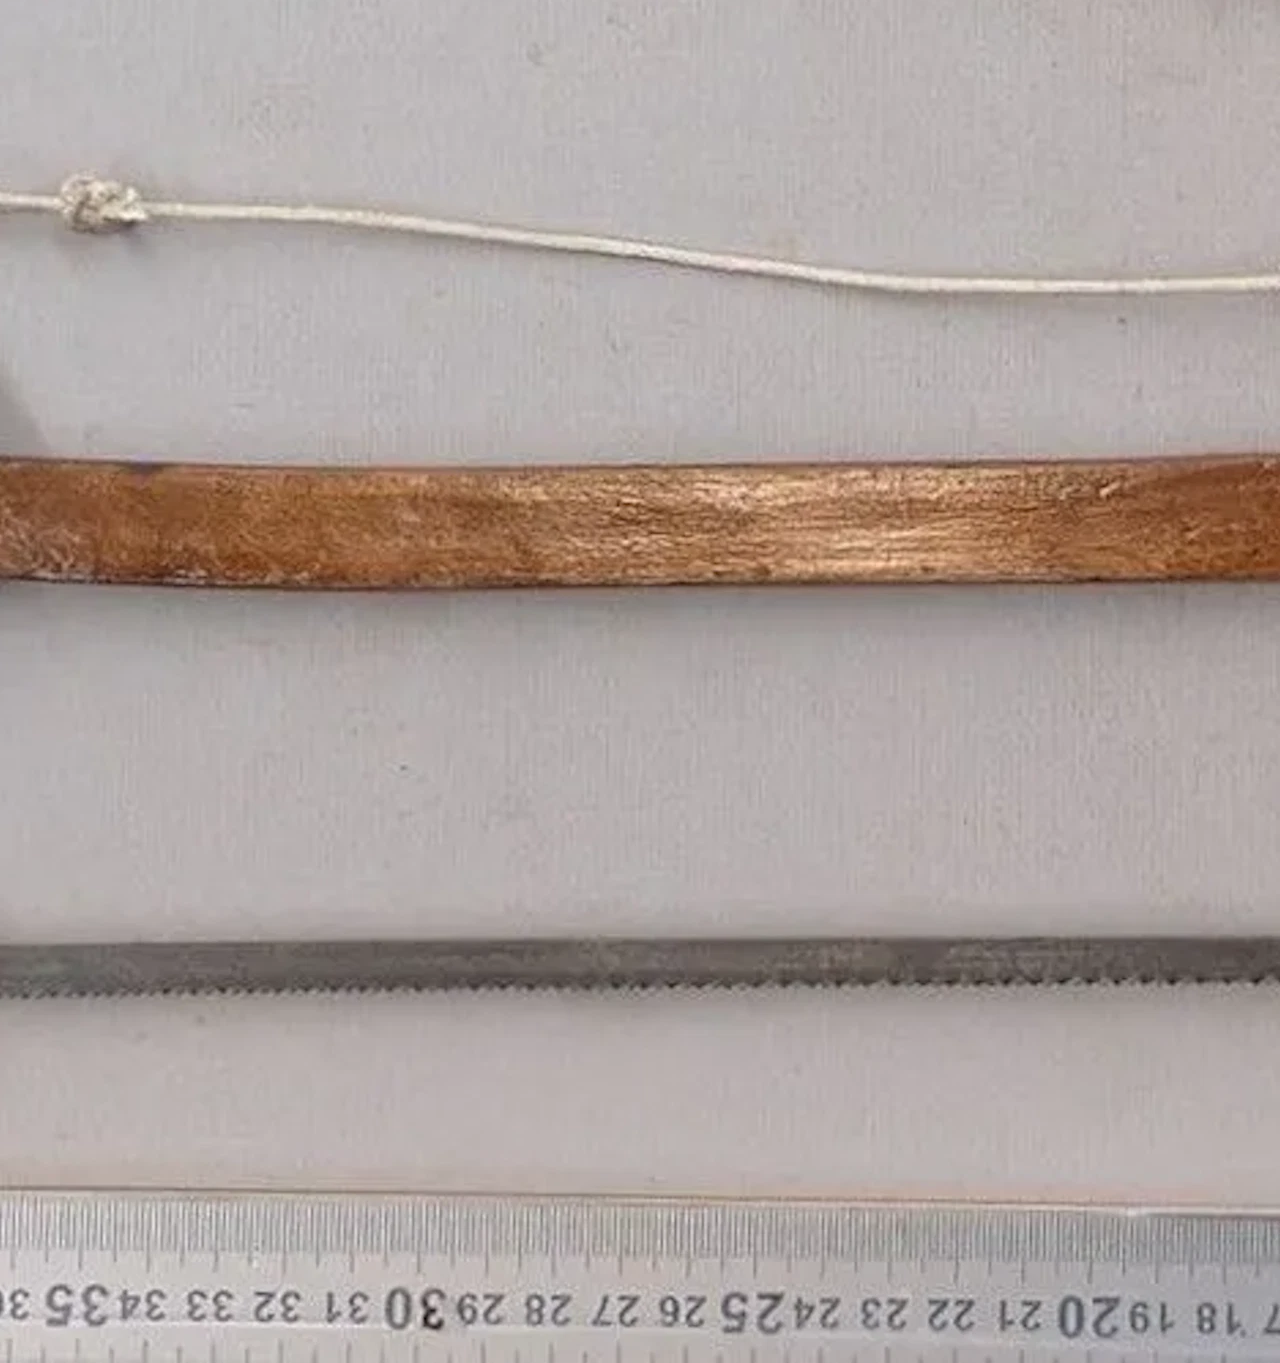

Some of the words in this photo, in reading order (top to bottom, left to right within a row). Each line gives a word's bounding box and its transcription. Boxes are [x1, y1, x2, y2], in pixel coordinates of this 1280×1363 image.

[45, 1283, 111, 1328] 35
[117, 1288, 167, 1322] 34
[186, 1289, 234, 1323] 33
[253, 1290, 302, 1324] 32
[325, 1290, 370, 1325] 31
[384, 1286, 448, 1333] 30
[454, 1291, 506, 1328] 29
[524, 1292, 573, 1327] 28
[591, 1294, 641, 1328] 27
[658, 1295, 707, 1329] 26
[720, 1291, 785, 1336] 25
[793, 1296, 841, 1330] 24
[860, 1297, 909, 1331] 23
[927, 1298, 976, 1333] 22
[998, 1299, 1042, 1332] 21
[1057, 1295, 1121, 1340] 20
[1129, 1301, 1175, 1335] 19
[1196, 1301, 1242, 1336] 18
